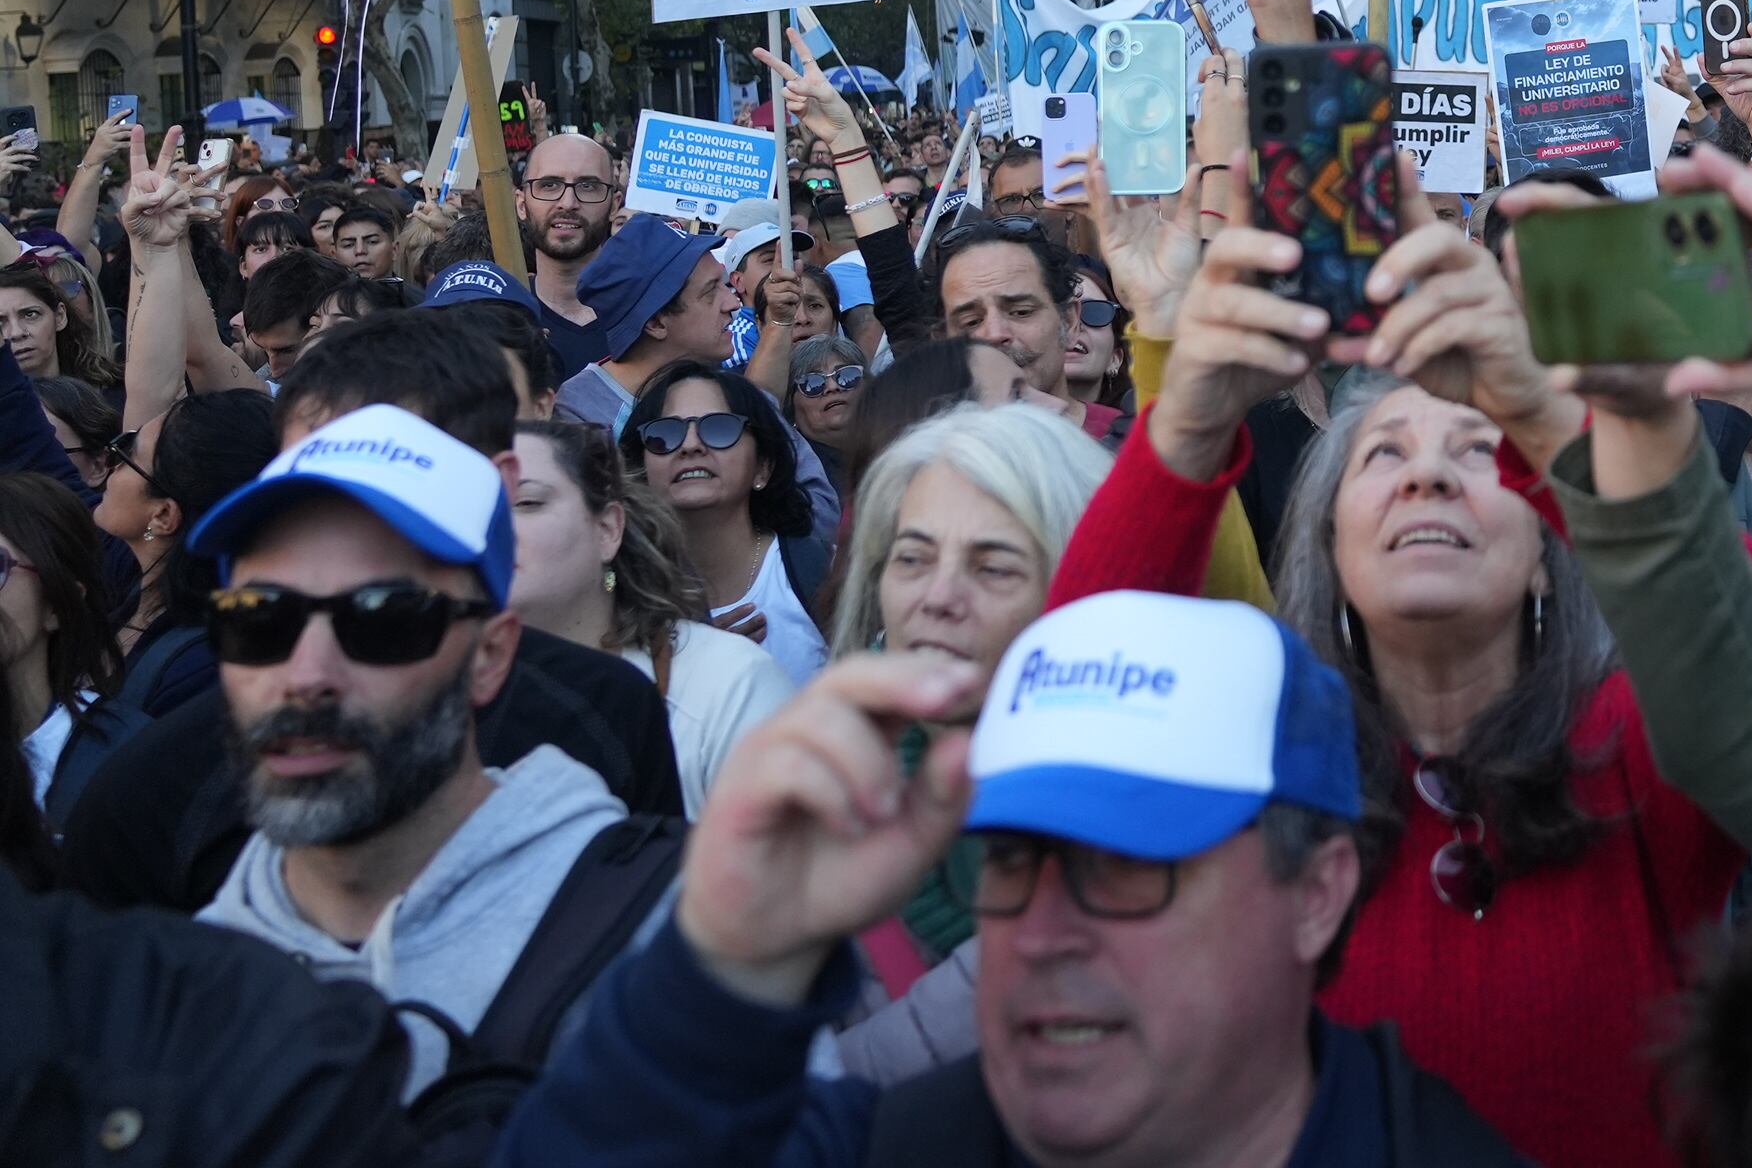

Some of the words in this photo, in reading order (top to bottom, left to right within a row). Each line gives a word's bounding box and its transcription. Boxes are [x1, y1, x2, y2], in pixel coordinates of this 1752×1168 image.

[1544, 56, 1572, 71] LEY
[1573, 55, 1592, 67] DE
[1514, 64, 1625, 89] FINANCIAMIENTO
[1400, 86, 1473, 117] DÍAS
[1521, 78, 1620, 102] UNIVERSITARIO
[1518, 104, 1539, 116] NO
[1541, 101, 1559, 113] ES
[1562, 93, 1628, 111] OPCIONAL
[669, 129, 685, 141] LA
[686, 132, 754, 153] CONQUISTA
[1392, 125, 1471, 147] umplir
[658, 139, 685, 153] MÁS
[686, 144, 736, 162] GRANDE
[736, 153, 761, 166] FUE
[644, 150, 670, 163] QUE
[671, 153, 687, 166] LA
[688, 157, 769, 180] UNIVERSIDAD
[648, 163, 665, 175] SE
[665, 165, 705, 182] LLENÓ
[705, 173, 722, 185] DE
[723, 175, 761, 190] HIJOS
[665, 178, 683, 190] DE
[683, 182, 740, 200] OBREROS
